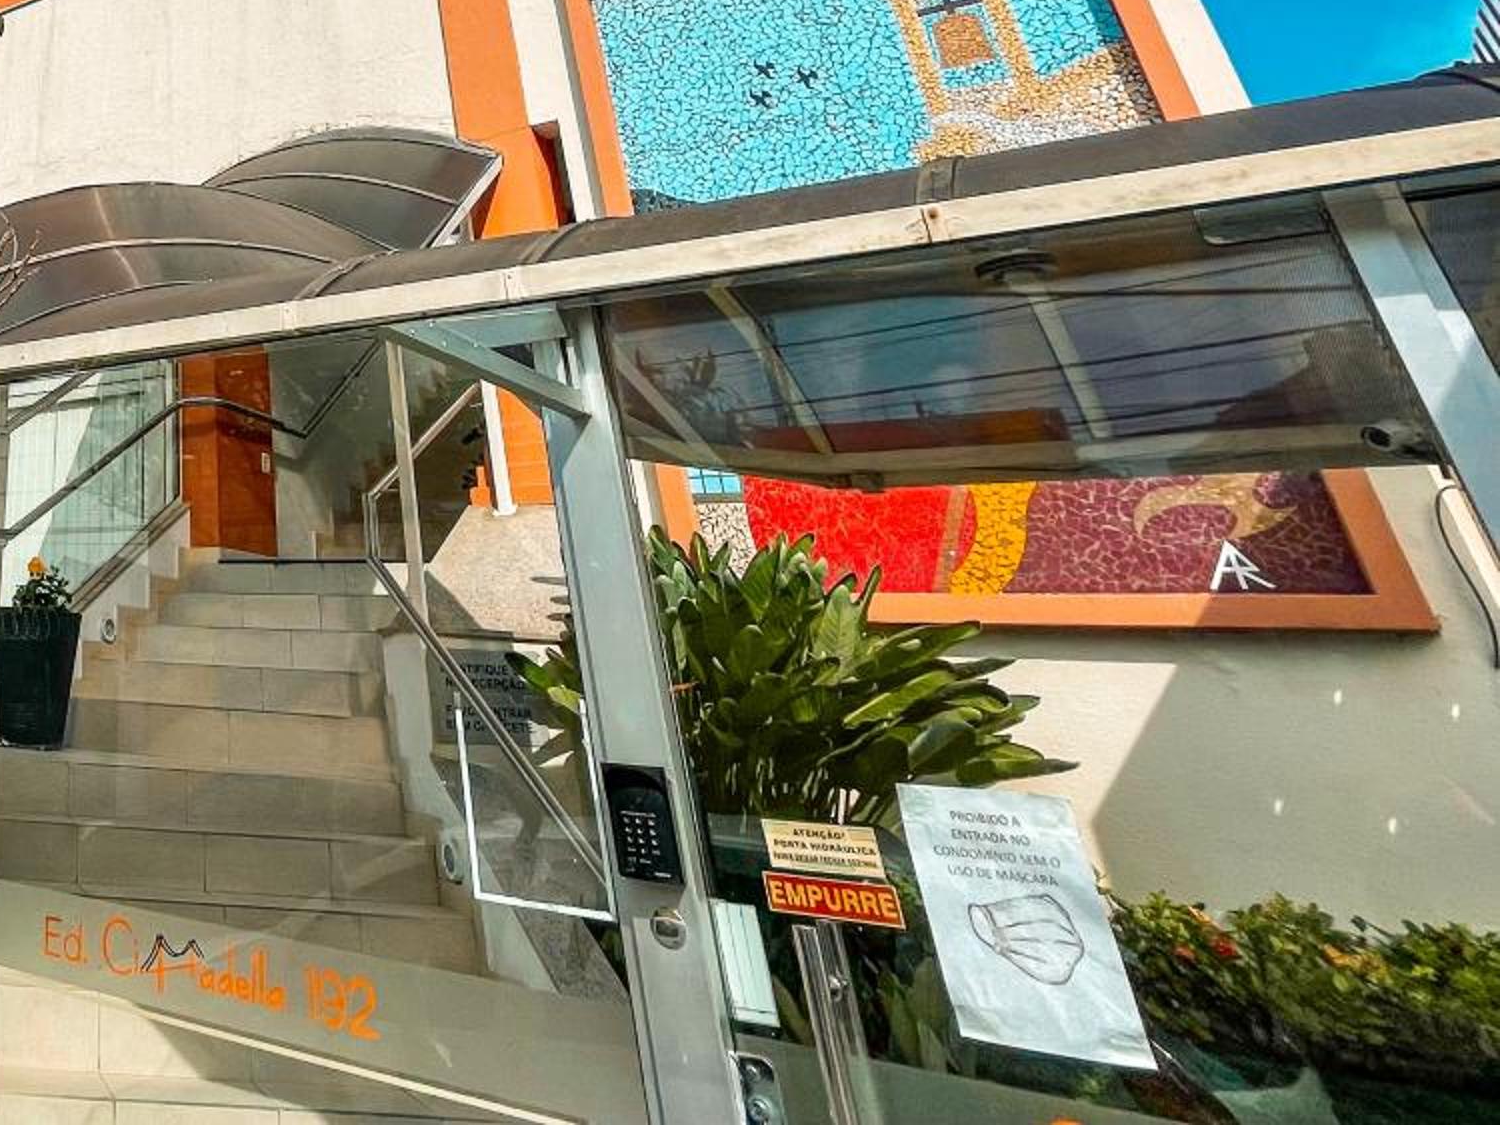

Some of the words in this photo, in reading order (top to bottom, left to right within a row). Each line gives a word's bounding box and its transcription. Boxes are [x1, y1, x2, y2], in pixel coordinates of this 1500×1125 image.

[949, 810, 1008, 826] PROIBIDO
[1012, 815, 1021, 827] A
[773, 838, 808, 850] PORTA
[950, 828, 1008, 844] ENTRADA
[1010, 834, 1030, 846] NO
[1019, 854, 1047, 867] SEM
[1050, 857, 1061, 869] O
[947, 864, 973, 878] USO
[975, 867, 992, 879] DE
[769, 880, 899, 918] EMPURRE
[42, 915, 88, 964] Ed.
[305, 964, 381, 1042] 192
